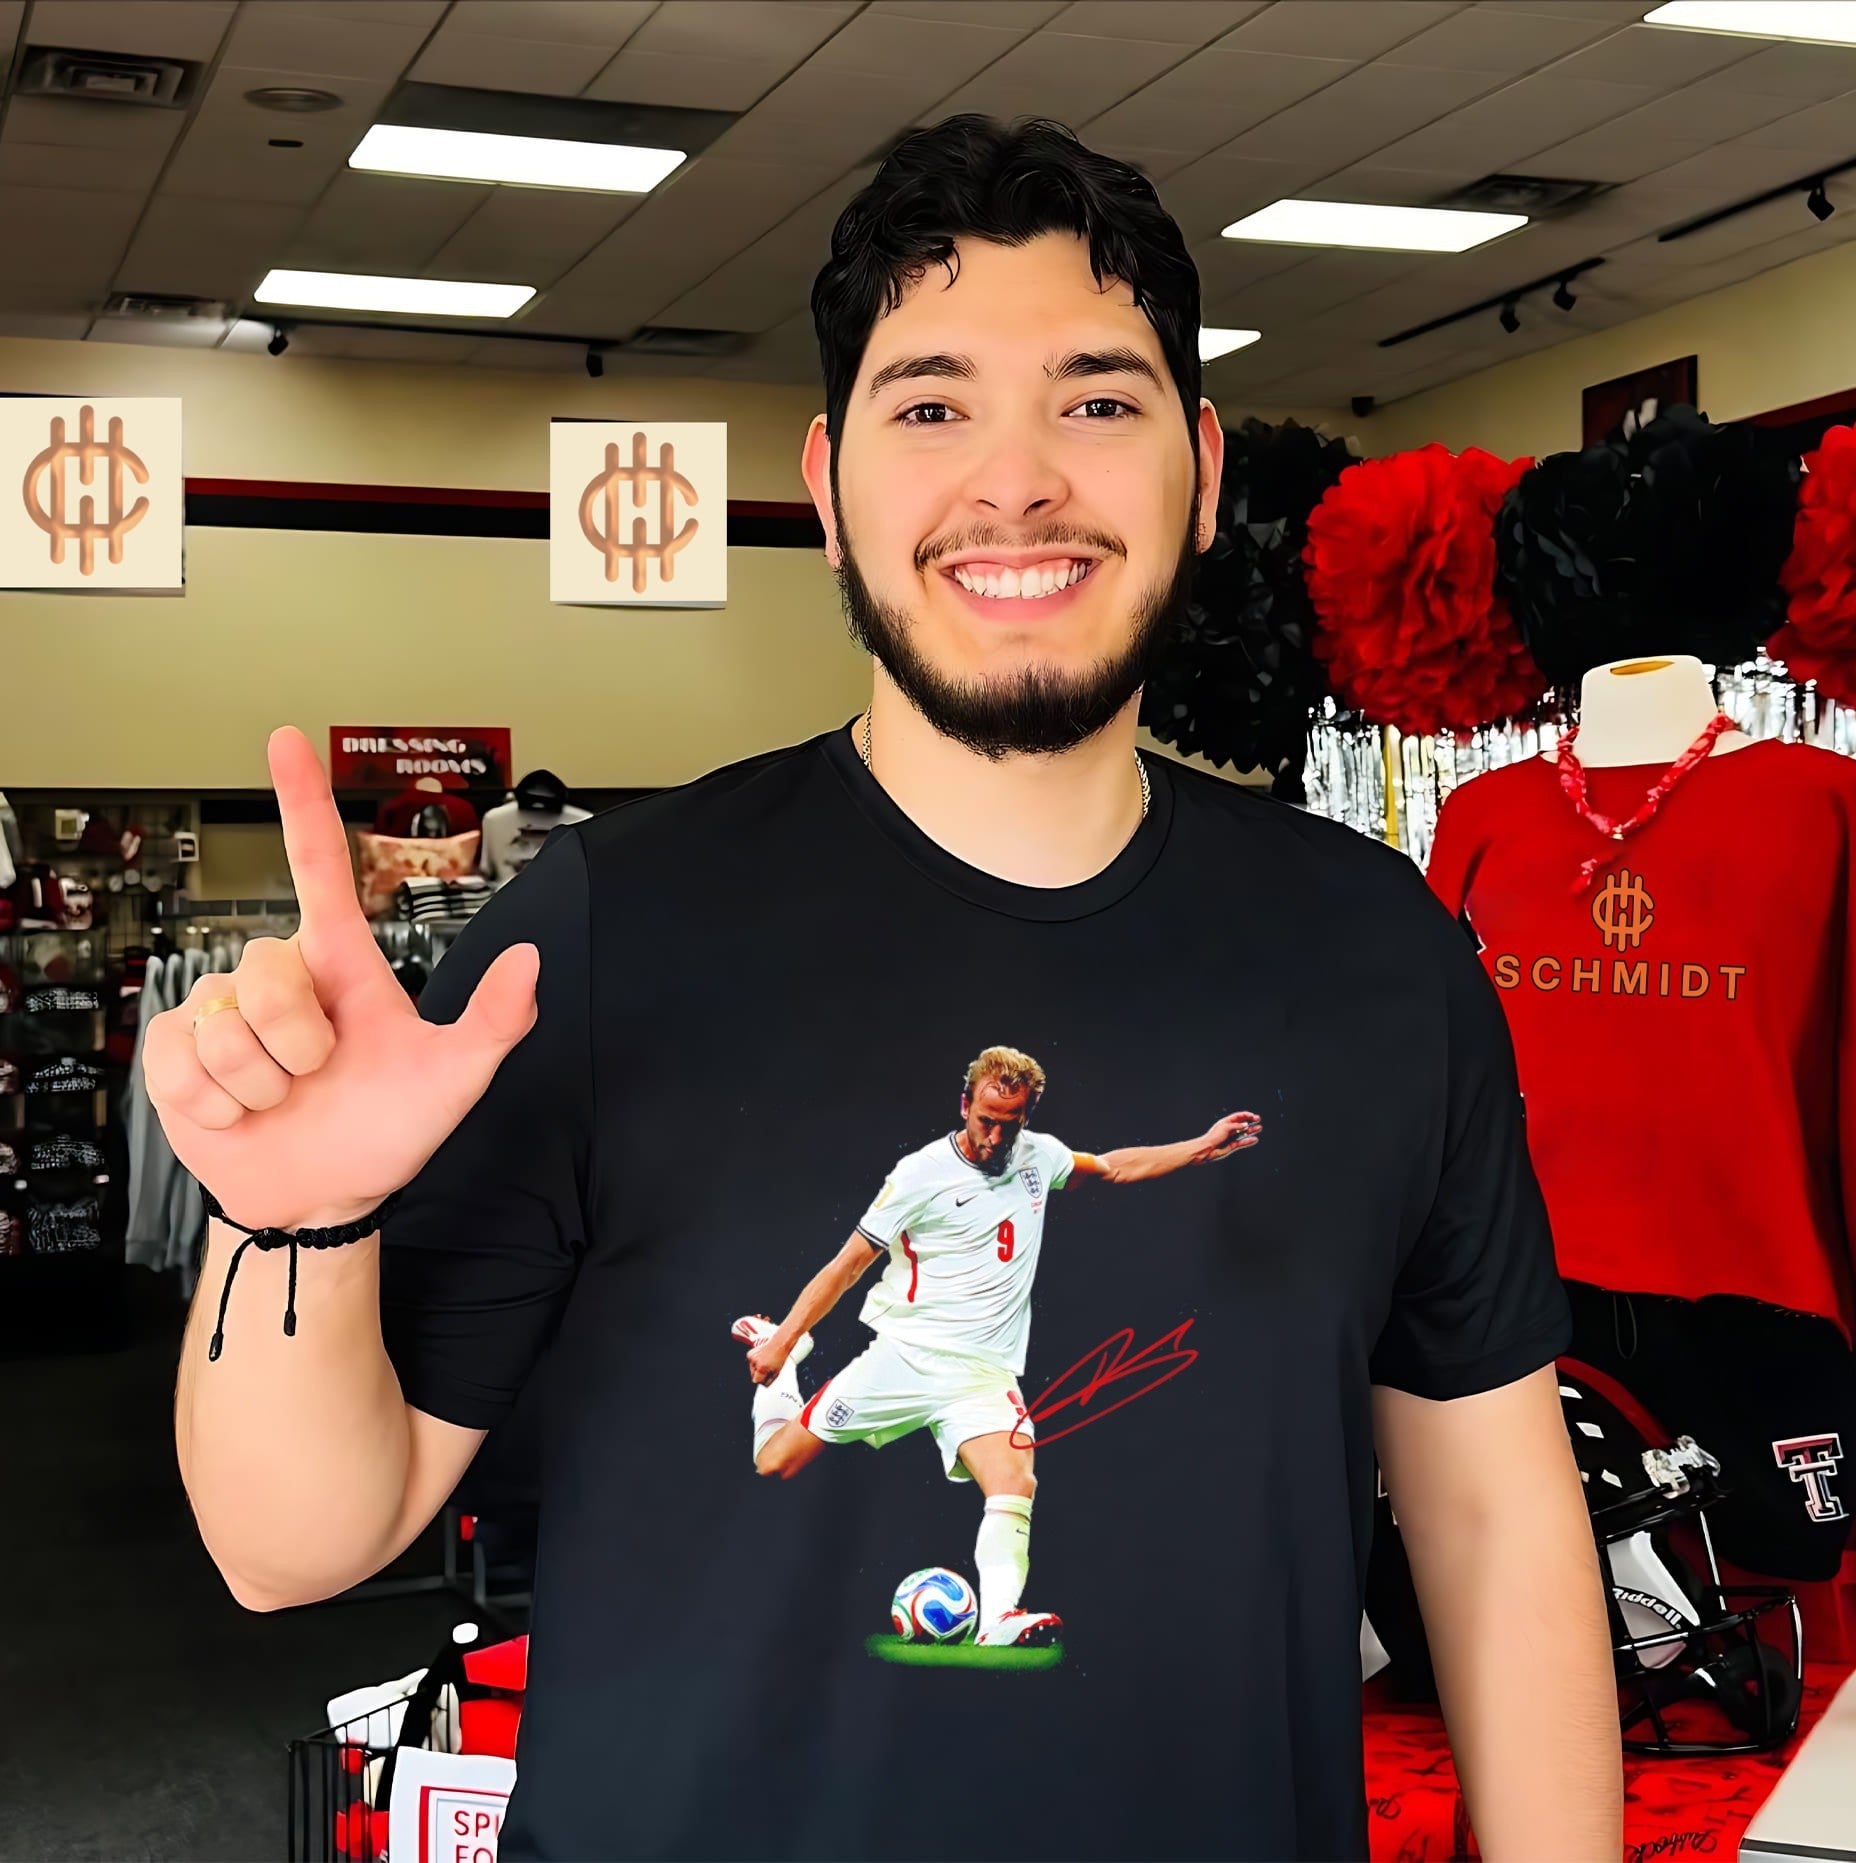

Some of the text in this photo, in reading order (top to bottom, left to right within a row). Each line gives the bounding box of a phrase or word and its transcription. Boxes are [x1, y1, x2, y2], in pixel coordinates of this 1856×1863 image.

[396, 758, 487, 775] ROOMS
[1494, 954, 1746, 1000] SCHMIDT
[997, 1219, 1014, 1263] 9
